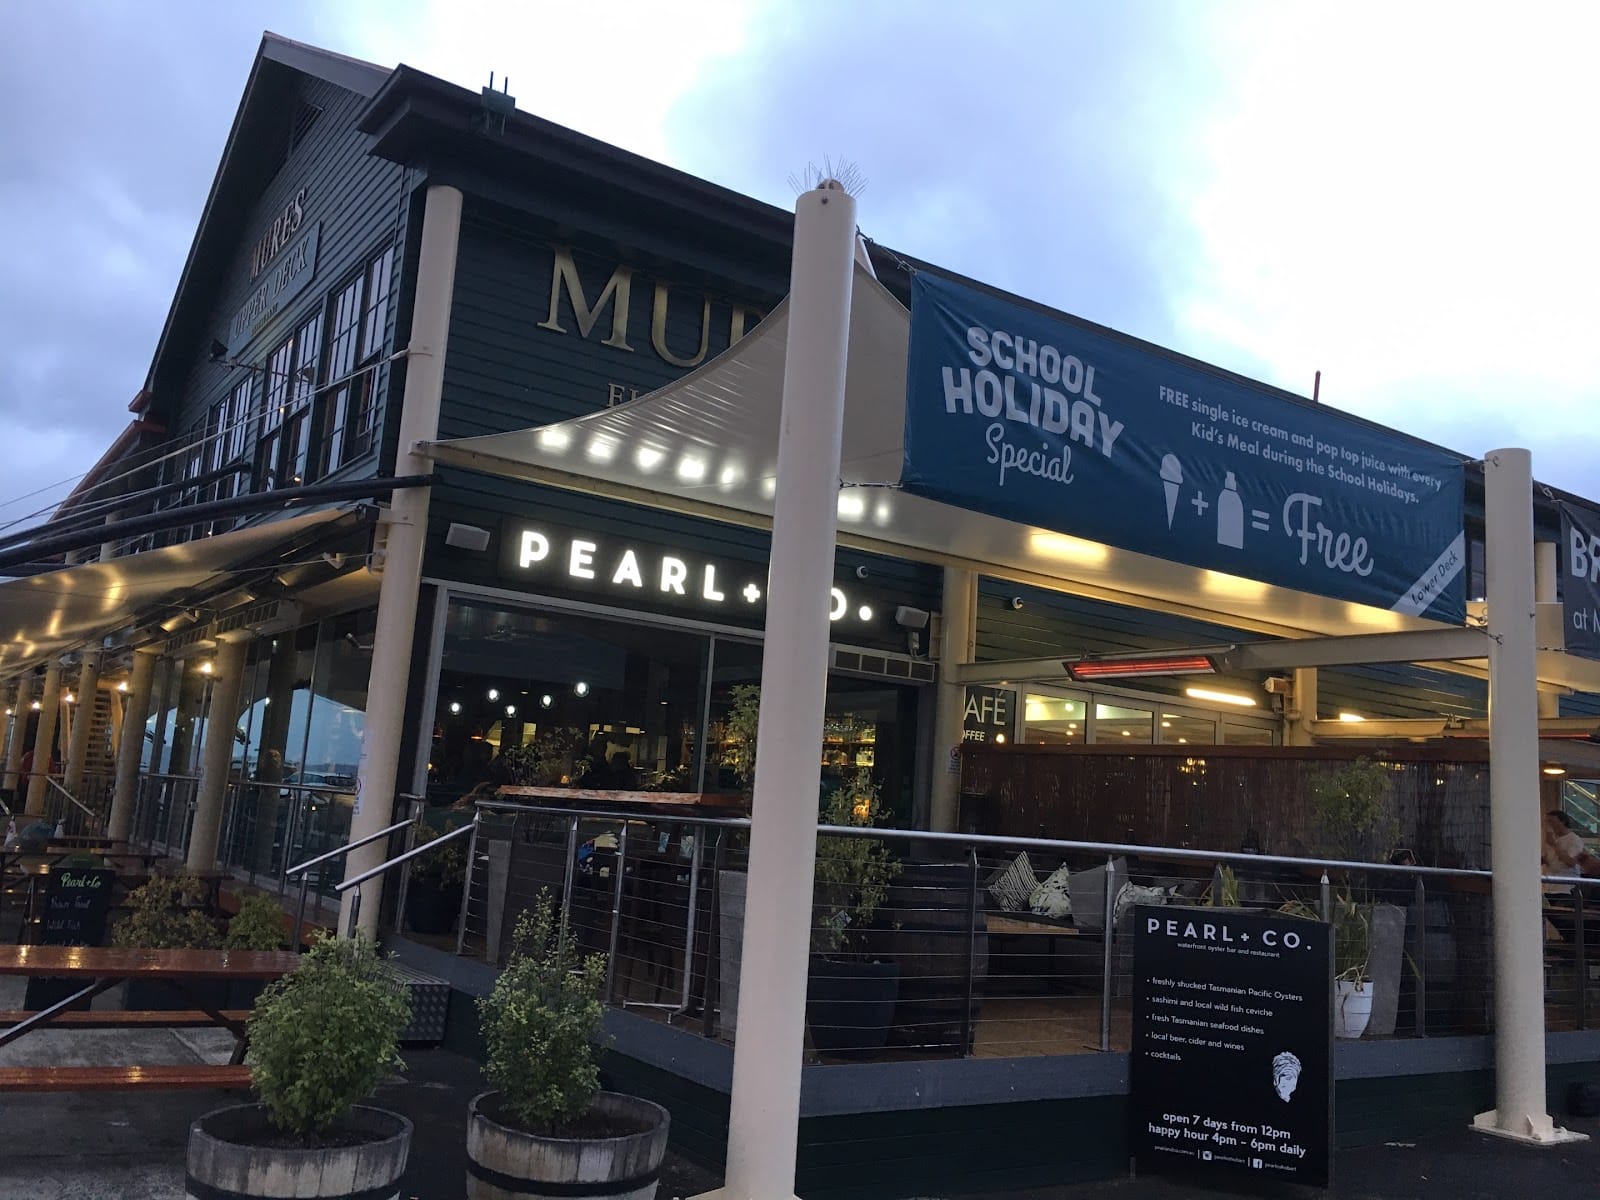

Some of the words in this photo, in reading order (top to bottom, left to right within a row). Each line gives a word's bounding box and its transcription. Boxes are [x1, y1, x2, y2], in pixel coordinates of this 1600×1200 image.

[250, 187, 307, 282] MURES
[234, 285, 269, 338] UPPER
[272, 236, 310, 298] DECK
[967, 326, 1102, 407] SCHOOL
[942, 366, 1125, 458] HOLIDAY
[985, 422, 1074, 486] Special
[1160, 385, 1189, 409] FREE
[1191, 397, 1229, 422] single
[1232, 409, 1249, 428] ice
[1251, 420, 1289, 441] cream
[1291, 432, 1314, 449] and
[1316, 441, 1338, 460] pop
[1341, 446, 1360, 467] top
[1361, 450, 1386, 472] juice
[1387, 462, 1410, 480] with
[1412, 471, 1442, 492] every
[1191, 421, 1224, 445] Kid's
[1227, 433, 1259, 456] Meal
[1262, 443, 1303, 473] during
[1306, 457, 1325, 475] the
[1328, 464, 1365, 488] School
[1367, 475, 1419, 504] Holidays.
[1282, 492, 1375, 577] Free
[519, 530, 725, 602] PEARL
[1411, 574, 1438, 606] Lower
[1438, 550, 1458, 577] Deck
[1573, 607, 1588, 631] at
[964, 690, 1006, 726] AFÉ
[1147, 918, 1234, 942] PEARL
[1262, 930, 1312, 951] CO.
[1177, 942, 1207, 950] waterfront
[1207, 944, 1225, 952] oyster
[1250, 950, 1280, 958] restaurant
[1151, 995, 1178, 1005] sashimi
[1180, 998, 1193, 1007] and
[1195, 1000, 1212, 1010] local
[1214, 1002, 1229, 1012] wild
[1231, 1004, 1244, 1014] fish
[1245, 1007, 1273, 1017] ceviche
[1152, 977, 1175, 988] freshly
[1177, 980, 1206, 991] shucked
[1208, 983, 1246, 995] Tasmanian
[1248, 988, 1273, 998] Pacific
[1274, 991, 1303, 1002] Oysters
[1151, 1013, 1169, 1023] fresh
[1171, 1015, 1208, 1028] Tasmanian
[1210, 1021, 1239, 1032] seafood
[1241, 1025, 1264, 1035] dishes
[1151, 1031, 1168, 1041] local
[1169, 1033, 1187, 1044] beer,
[1188, 1036, 1206, 1046] cider
[1208, 1039, 1222, 1048] and
[1223, 1042, 1244, 1051] wines
[1150, 1051, 1182, 1061] cocktails
[1148, 1123, 1180, 1139] happy
[1183, 1127, 1209, 1141] hour
[1212, 1132, 1237, 1146] 4pm
[1250, 1138, 1276, 1152] 6pm
[1279, 1143, 1306, 1158] daily
[1162, 1112, 1190, 1125] open
[1192, 1114, 1200, 1125] 7
[1203, 1117, 1228, 1131] days
[1230, 1121, 1257, 1134] from
[1261, 1125, 1291, 1139] 12pm
